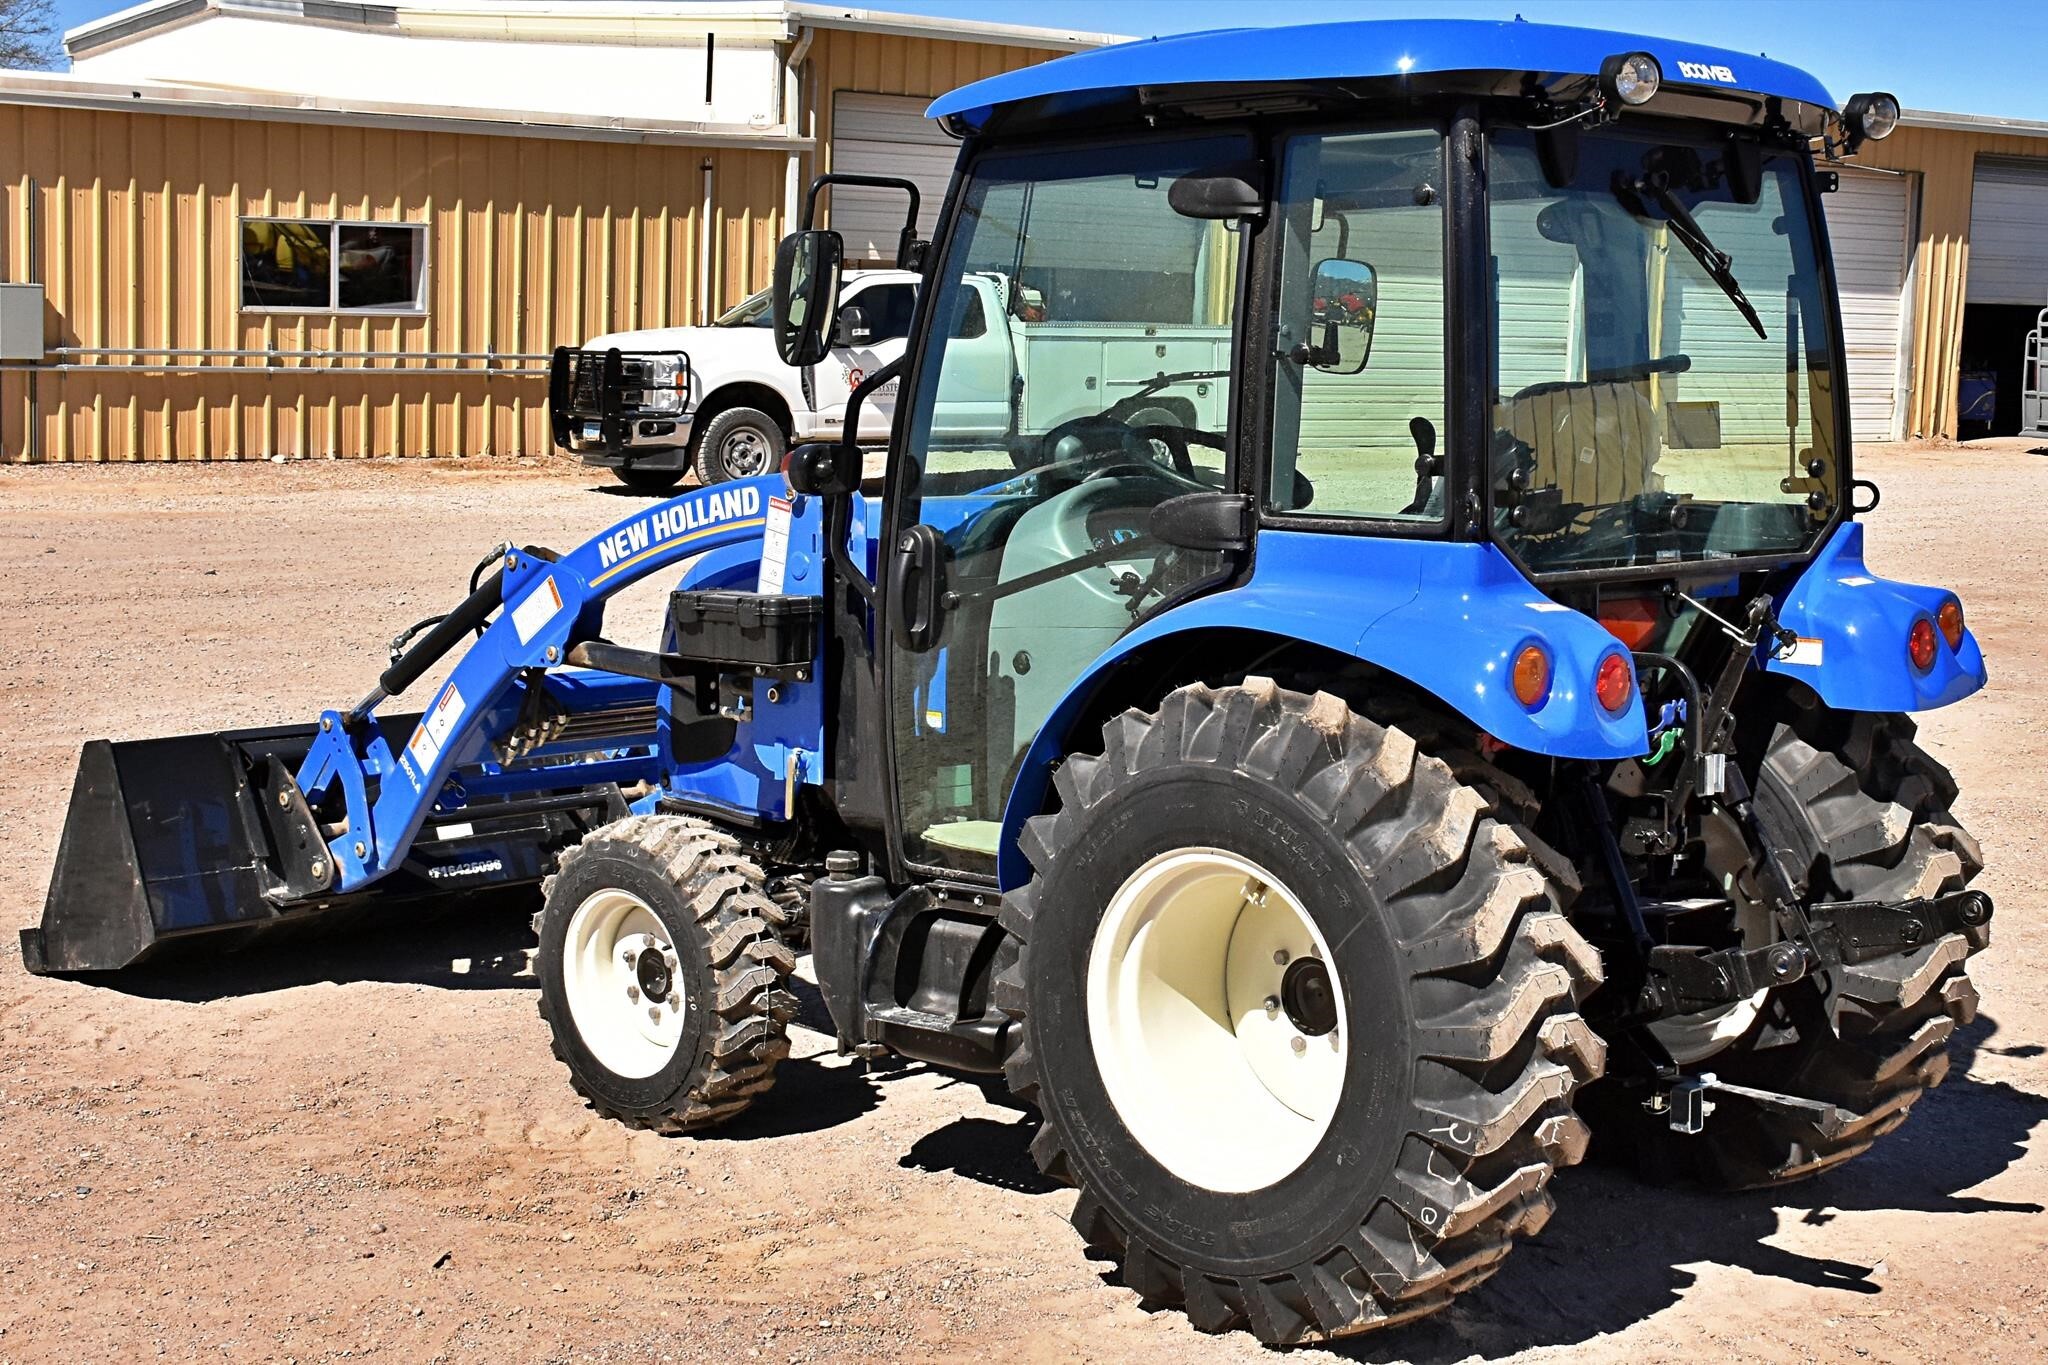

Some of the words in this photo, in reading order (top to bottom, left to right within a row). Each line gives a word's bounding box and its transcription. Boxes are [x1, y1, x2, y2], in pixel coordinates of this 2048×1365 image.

[1677, 61, 1737, 83] BOOMER
[598, 519, 649, 568] NEW
[652, 486, 760, 542] HOLLAND
